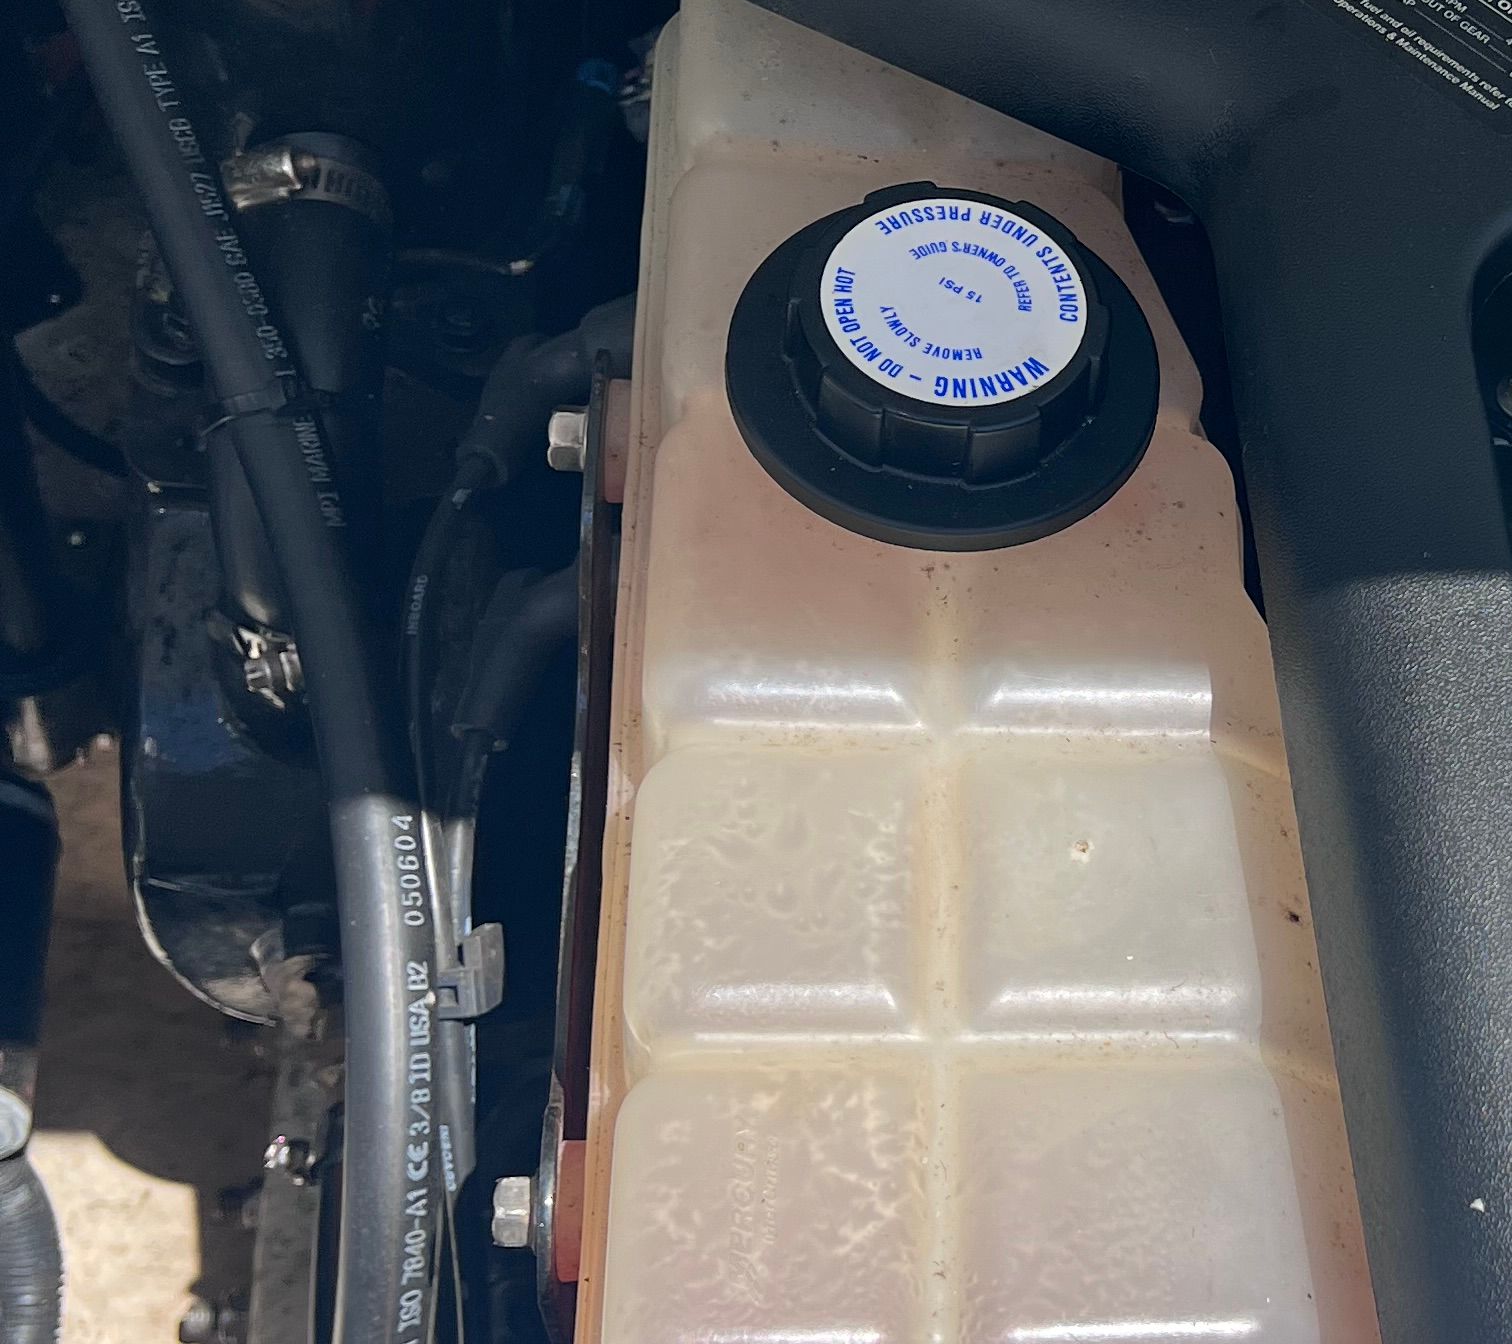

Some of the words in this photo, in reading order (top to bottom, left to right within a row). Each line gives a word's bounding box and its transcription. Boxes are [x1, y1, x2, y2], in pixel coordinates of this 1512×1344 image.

[1444, 10, 1460, 23] OF
[1460, 21, 1490, 45] GEAR
[1380, 11, 1403, 28] and
[1401, 26, 1417, 39] oil
[1415, 35, 1480, 83] requirements
[1479, 79, 1506, 99] refer
[143, 61, 181, 112] TYPE
[1396, 37, 1460, 85] Maintenance
[1459, 81, 1500, 111] Manual
[875, 206, 971, 236] PRESSURE
[980, 208, 1039, 248] UNDER
[908, 240, 948, 261] GUIDE
[951, 242, 1005, 267] OWNER'S
[833, 266, 857, 294] HOT
[938, 277, 963, 295] PSI
[1002, 262, 1020, 279] TO
[1036, 245, 1079, 323] CONTENTS
[966, 291, 982, 304] 15
[1016, 279, 1033, 312] REFER
[834, 297, 862, 334] OPEN
[879, 304, 920, 349] SLOWLY
[849, 335, 881, 366] NOT
[877, 356, 904, 379] DO
[923, 341, 983, 361] REMOVE
[933, 355, 1050, 400] WARNING
[391, 814, 425, 927] 050604
[406, 960, 429, 991] B2
[408, 997, 431, 1046] USA
[409, 1052, 431, 1084] ID
[408, 1087, 431, 1136] 3/8
[406, 1141, 429, 1181] CE
[400, 1187, 428, 1286] 7840-A1
[398, 1289, 423, 1334] ISO
